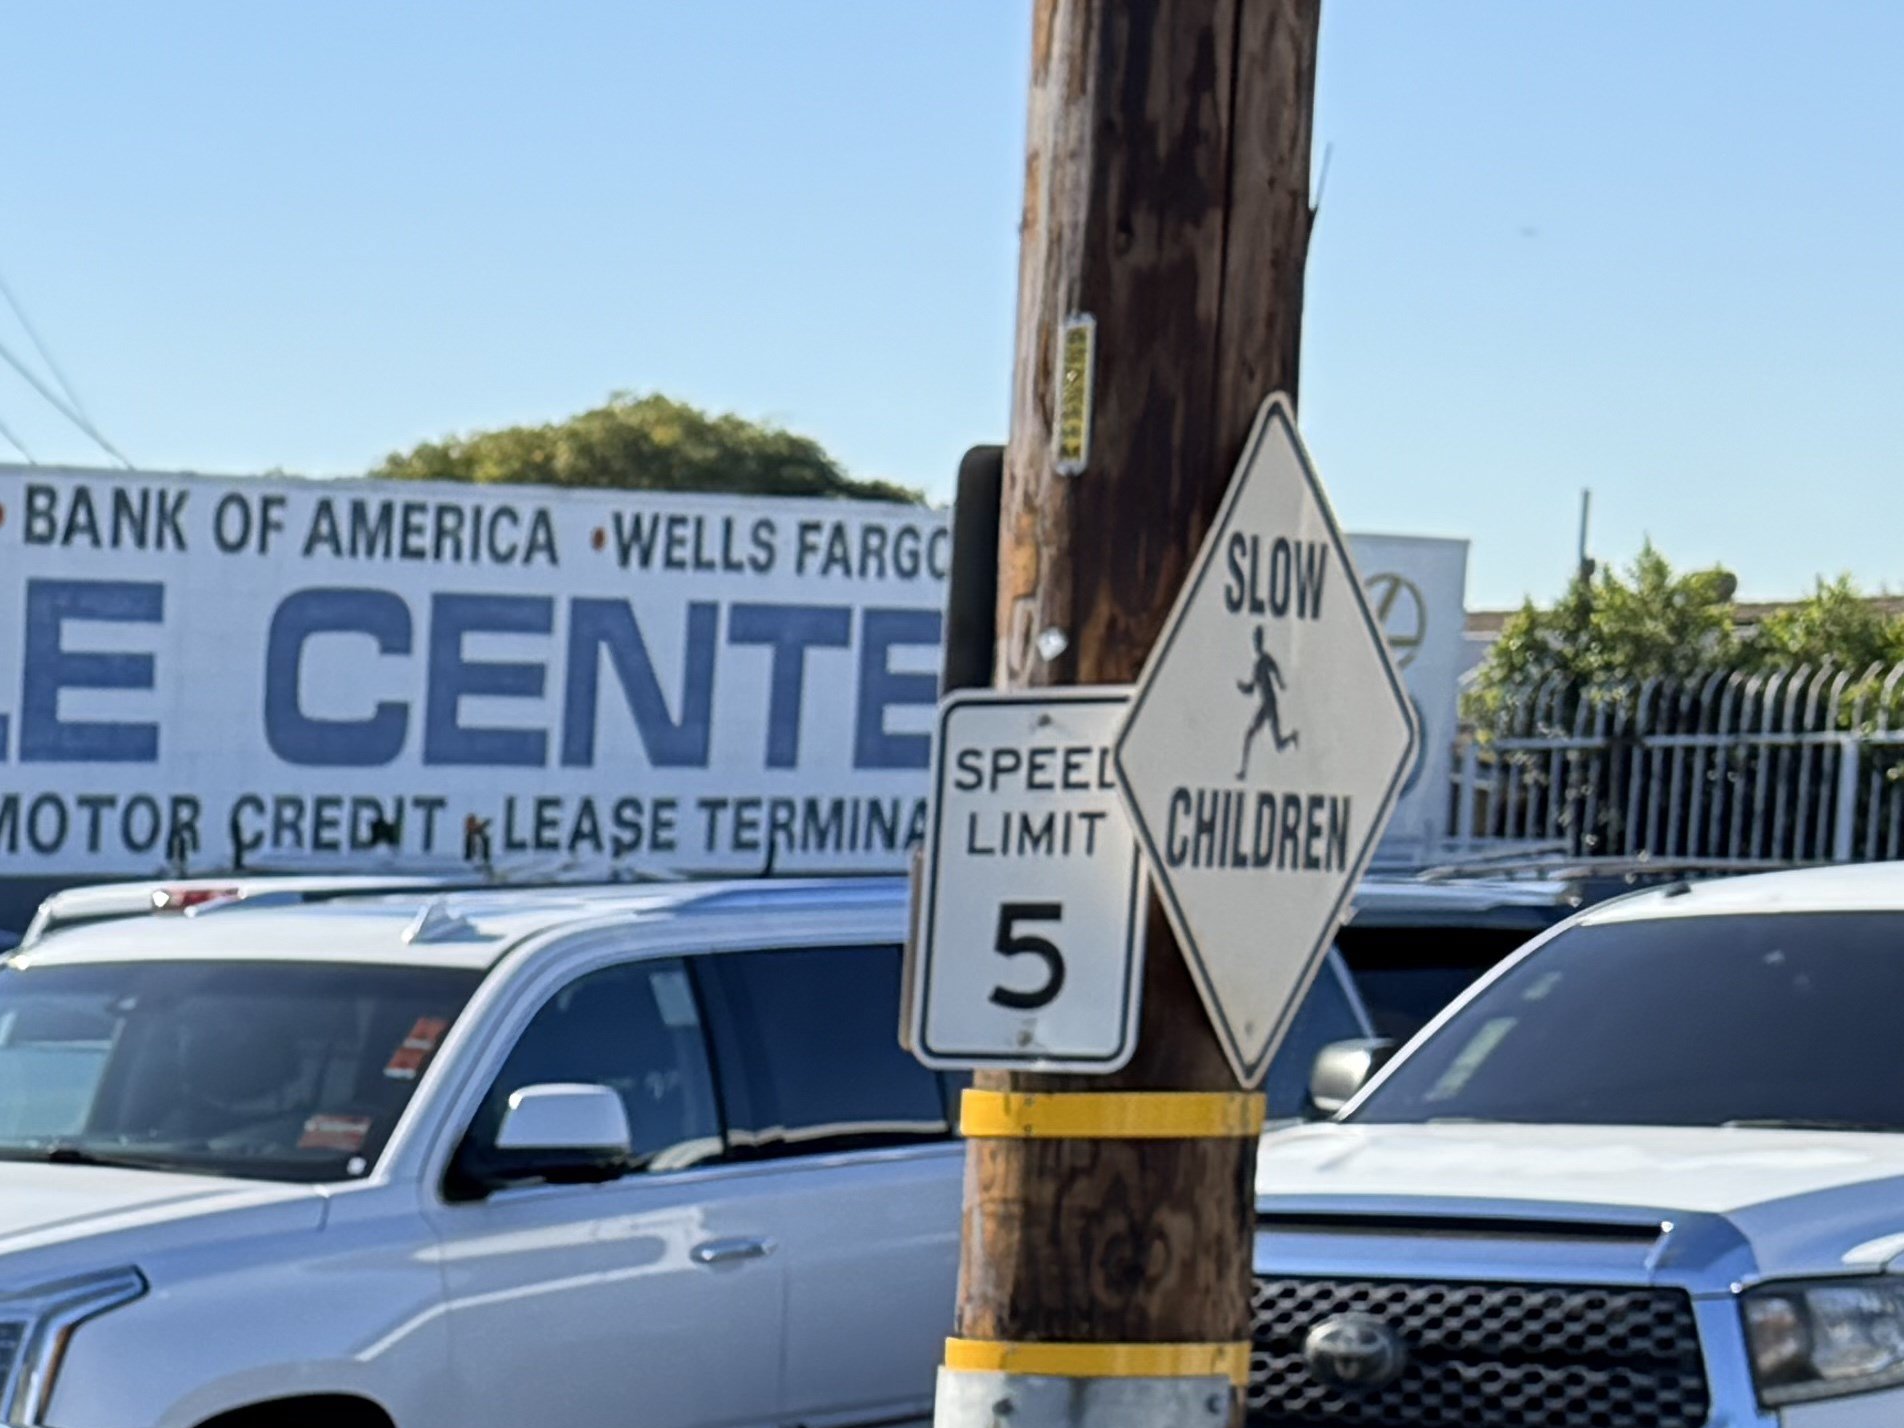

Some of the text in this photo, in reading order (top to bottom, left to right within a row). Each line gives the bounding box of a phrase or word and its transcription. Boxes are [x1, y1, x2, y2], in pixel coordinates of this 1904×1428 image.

[23, 482, 192, 551] BANK
[212, 492, 288, 557] OF
[301, 497, 560, 567] AMERICA
[611, 510, 777, 574] WELLS
[794, 521, 949, 580] FARGO
[1224, 531, 1328, 621] SLOW
[230, 794, 447, 854] CREDIT
[503, 795, 676, 854] LEASE
[967, 811, 1107, 857] LIMIT
[1165, 786, 1352, 873] CHILDREN
[988, 902, 1065, 1010] 5
